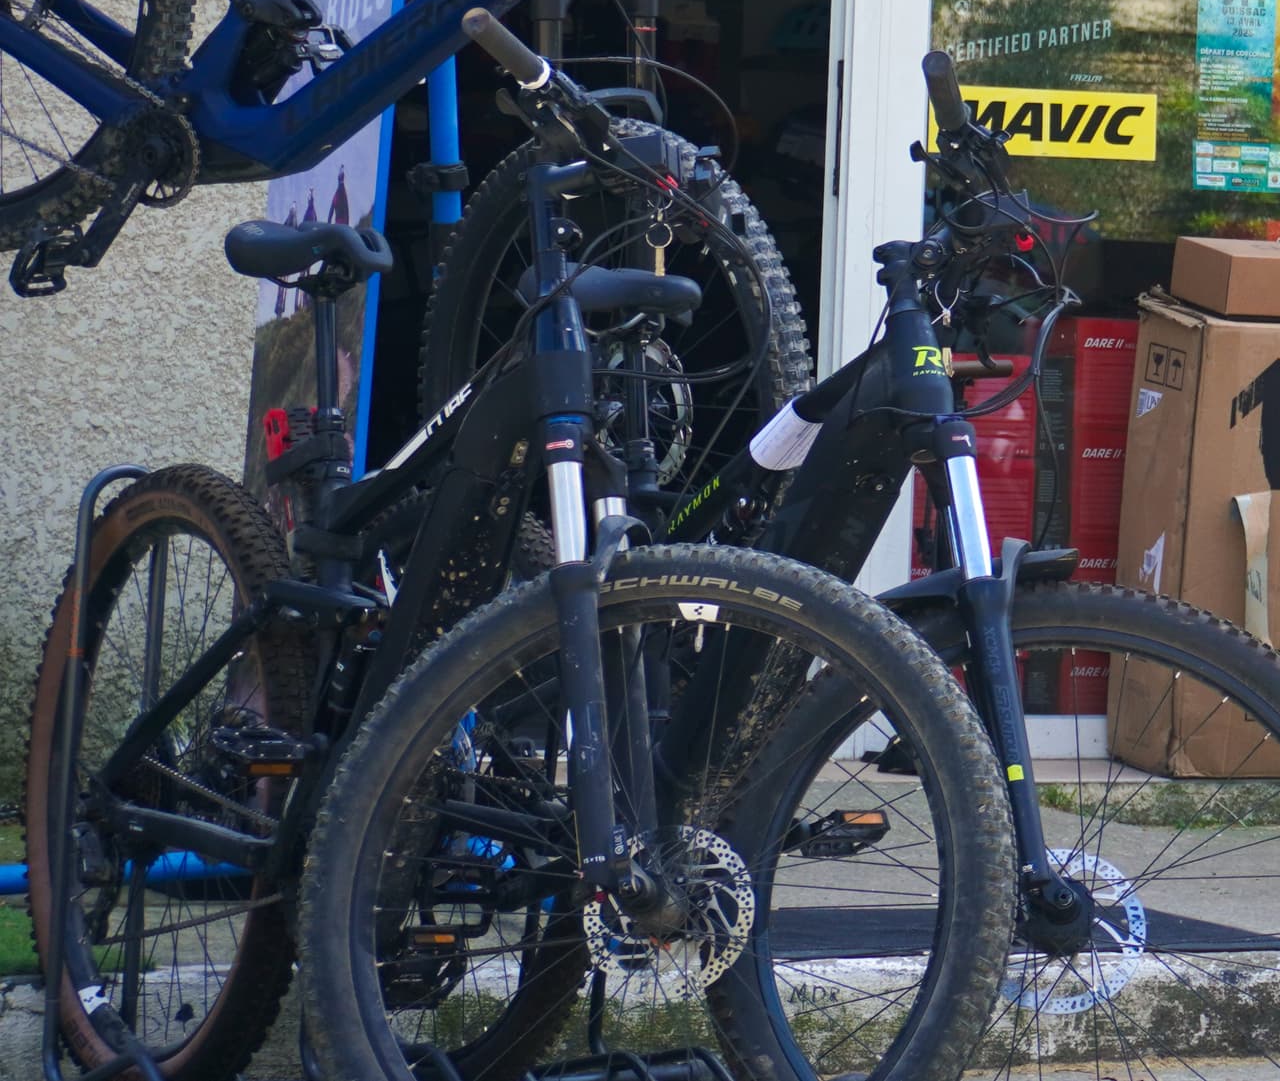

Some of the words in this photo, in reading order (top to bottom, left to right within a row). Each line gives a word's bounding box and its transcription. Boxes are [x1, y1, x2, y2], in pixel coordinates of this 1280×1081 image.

[946, 32, 1031, 62] CERTIFIED
[1038, 19, 1112, 49] PARTNER
[1200, 47, 1226, 56] DÉPART
[1226, 48, 1235, 57] DE
[961, 99, 1146, 146] MAVIC
[1084, 337, 1115, 348] DARE
[1082, 448, 1114, 459] DARE
[1079, 558, 1110, 568] DARE
[598, 574, 804, 612] SCHWALBE
[1069, 666, 1102, 678] DARE
